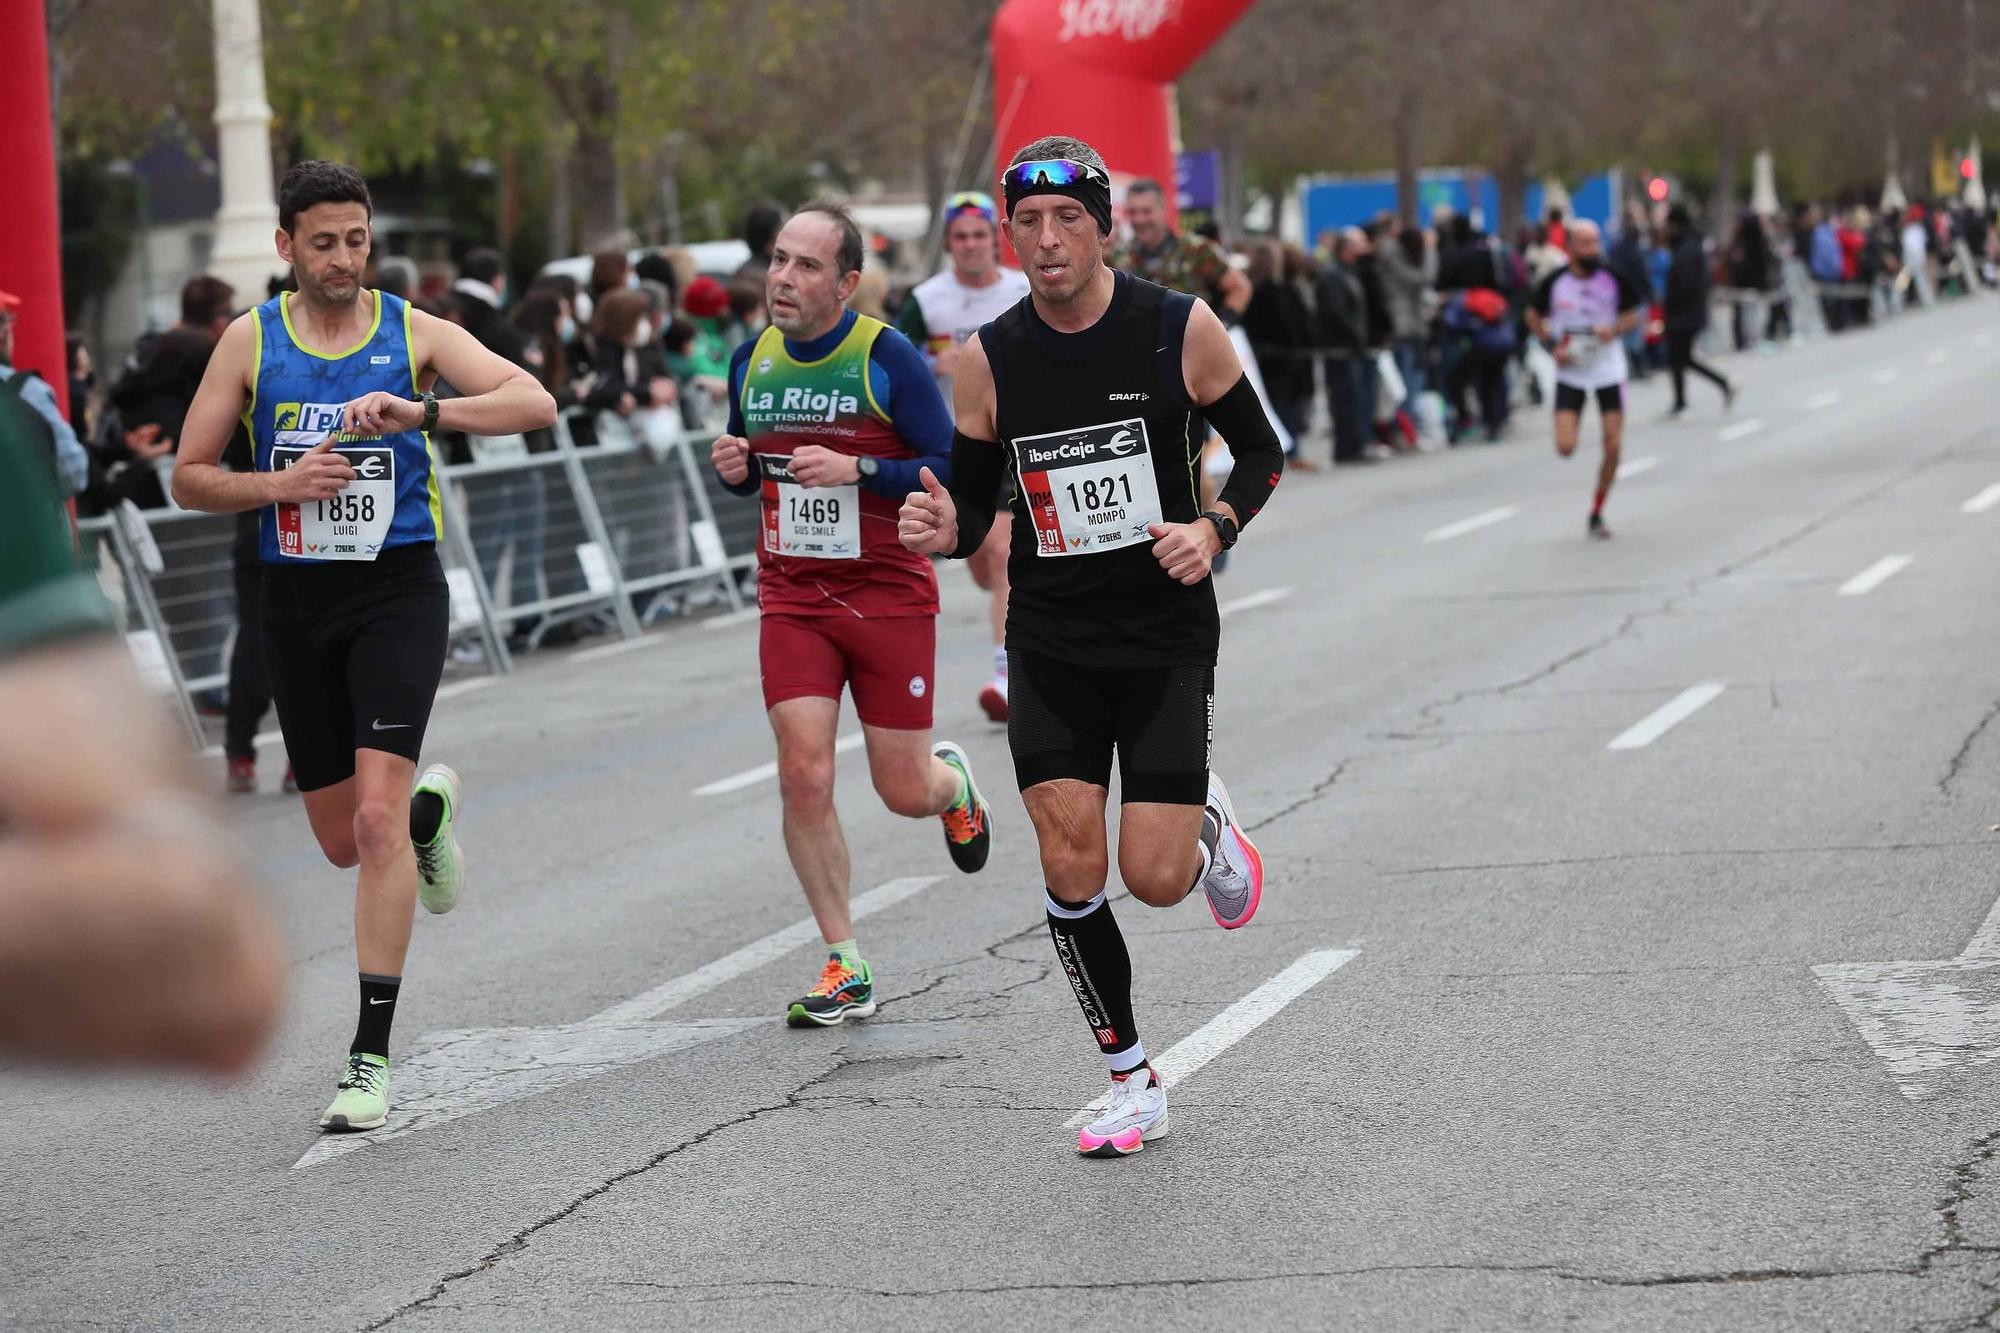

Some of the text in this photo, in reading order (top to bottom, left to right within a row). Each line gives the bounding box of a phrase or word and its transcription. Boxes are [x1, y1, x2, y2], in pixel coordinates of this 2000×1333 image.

[747, 387, 858, 422] La Rioja
[1109, 393, 1141, 401] CRAFT
[748, 413, 823, 422] ATLETISMO
[1028, 441, 1095, 463] iberCaja
[1066, 473, 1133, 513] 1821
[316, 494, 375, 522] 1858
[790, 497, 840, 523] 1469
[1087, 506, 1126, 526] MOMPÓ
[333, 525, 358, 536] LUIGI
[794, 525, 836, 536] GUS SMILE
[1046, 529, 1060, 545] 01
[1097, 531, 1122, 544] 226ERS
[286, 531, 299, 547] 01
[334, 544, 356, 553] 226ERS
